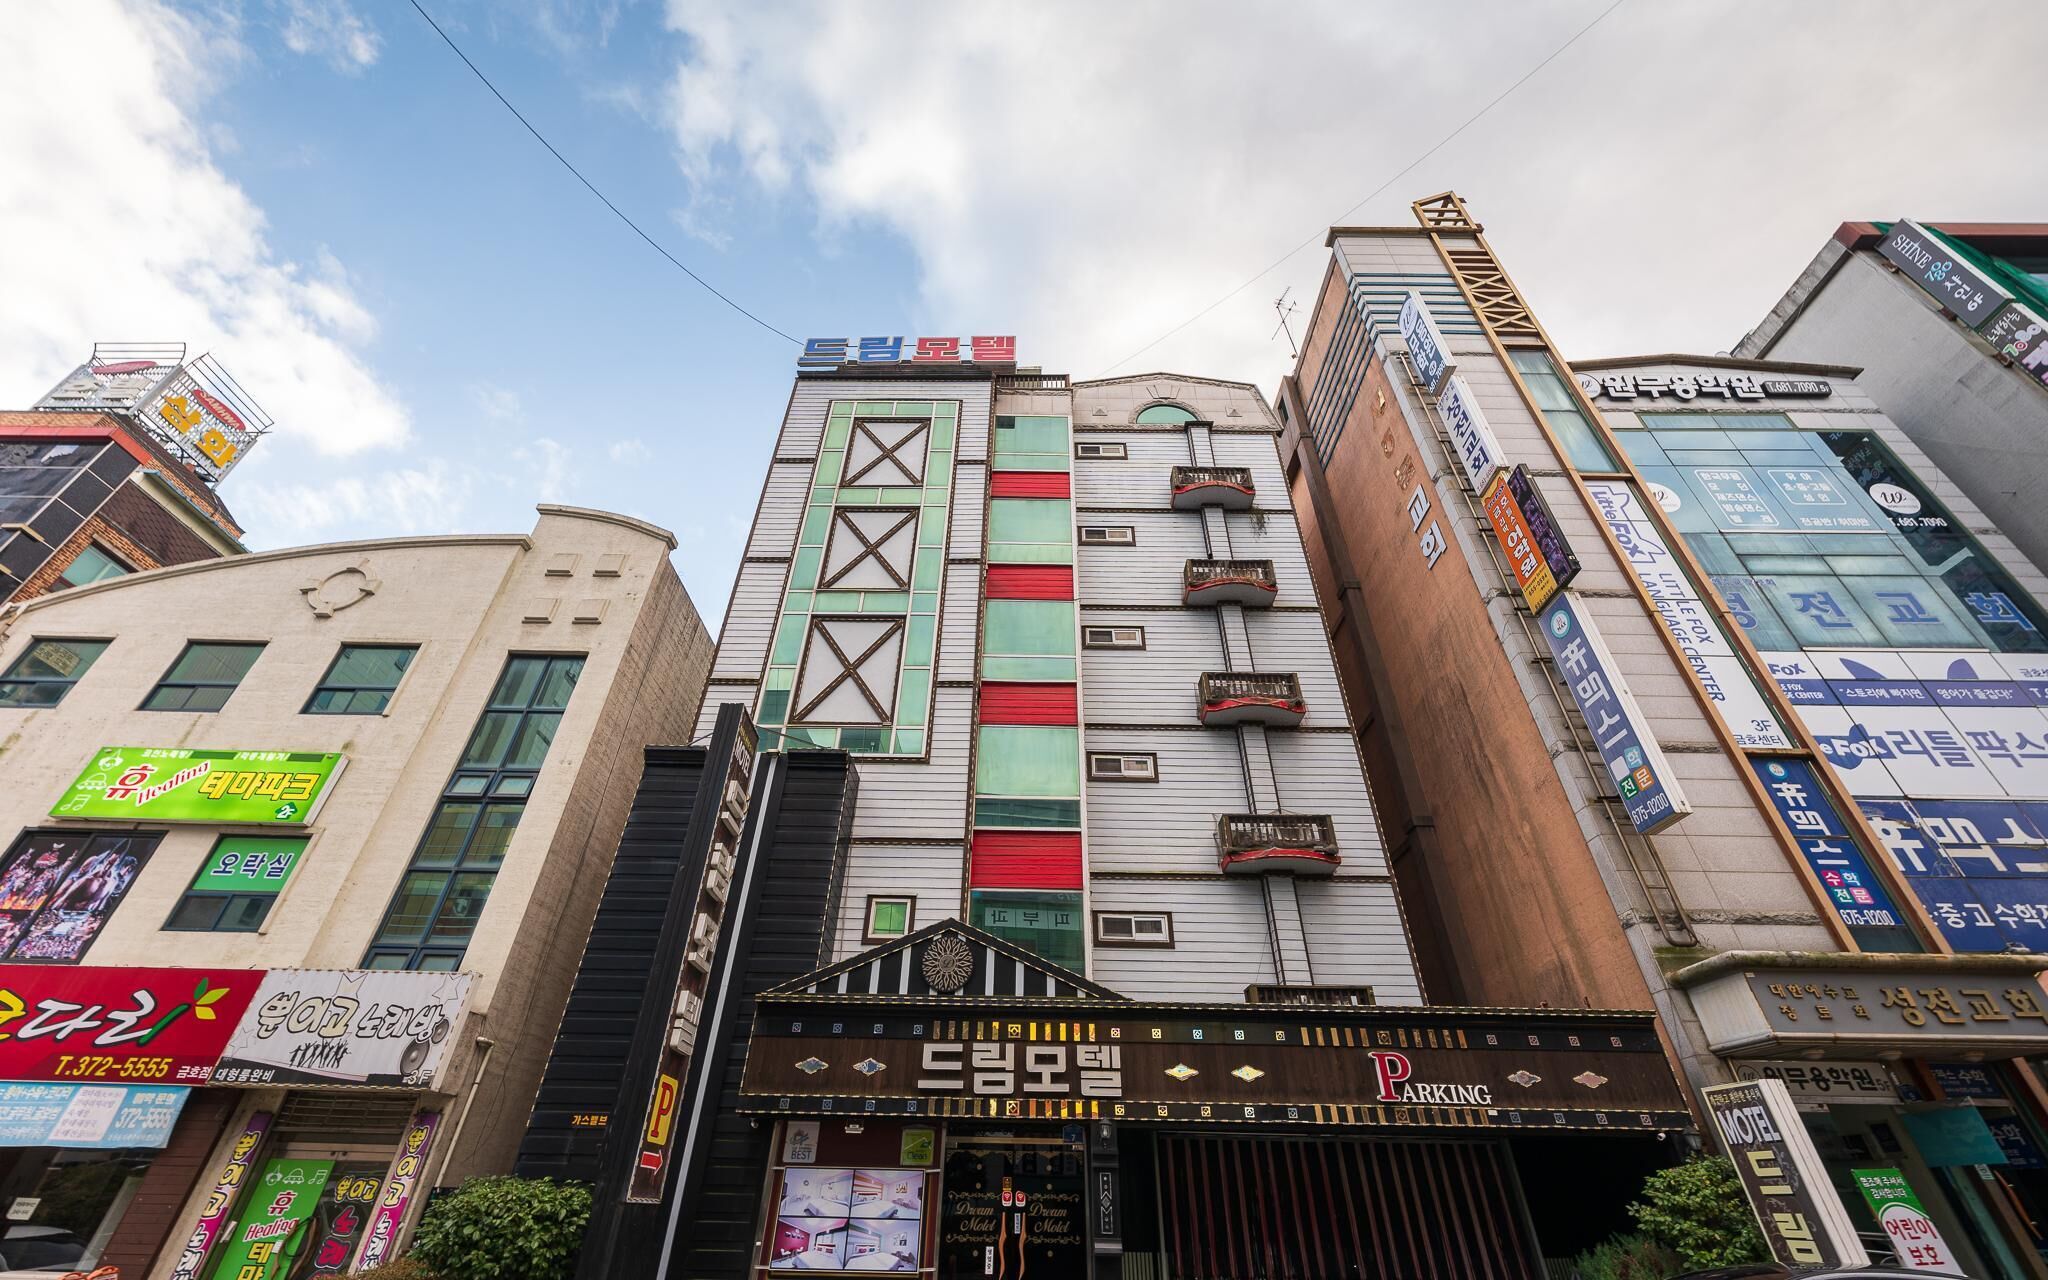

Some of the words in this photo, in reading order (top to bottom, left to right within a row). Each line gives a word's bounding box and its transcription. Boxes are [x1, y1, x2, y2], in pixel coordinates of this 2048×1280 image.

[1892, 233, 1933, 269] SHINE
[1967, 292, 1984, 312] 6F
[798, 335, 1017, 366] 드림모텔
[1602, 373, 1766, 401] 원무용학원
[1766, 381, 1818, 394] T.681.7090
[199, 389, 240, 430] SAMHWA
[159, 394, 238, 469] 삼화
[1446, 393, 1490, 478] 성전교회
[1591, 491, 1618, 520] Little
[1659, 573, 1697, 616] LITTLE
[1686, 618, 1715, 644] FOX
[1638, 573, 1692, 648] LANGUAGE
[1682, 647, 1726, 702] CENTER
[1561, 636, 1628, 750] 휴맥스
[1796, 691, 1824, 699] CENTER
[1889, 687, 1926, 700] 빠지면
[1937, 687, 1972, 700] 영어가
[1750, 719, 1772, 732] 3F
[104, 763, 156, 800] 휴
[136, 760, 211, 806] Healing
[198, 770, 320, 801] 테마파크
[1631, 792, 1669, 826] 675-0200
[1771, 782, 1850, 865] 휴맥스
[210, 853, 293, 879] 오락실
[669, 780, 749, 1056] 드림모텔
[1840, 909, 1896, 926] 675-0200
[1768, 983, 1861, 1000] 대한예수교
[1880, 986, 2048, 1027] 성전교회
[356, 1003, 446, 1044] 노래방
[54, 1056, 173, 1079] T.372-5555
[176, 1066, 213, 1080] 금호점
[215, 1068, 276, 1083] 대형룸완비
[917, 1042, 1123, 1097] 드림모텔
[1368, 1051, 1492, 1105] PARKING
[115, 1107, 175, 1129] 372-5555
[1716, 1105, 1782, 1145] MOTEL
[791, 1150, 811, 1160] BEST
[267, 1190, 298, 1216] 휴
[955, 1201, 995, 1217] Dream
[1028, 1202, 1068, 1217] Dream
[1746, 1149, 1825, 1263] 드림
[960, 1216, 997, 1232] Motel
[1034, 1217, 1071, 1233] Motel
[1886, 1217, 1938, 1241] 어린이
[1907, 1243, 1945, 1267] 보호
